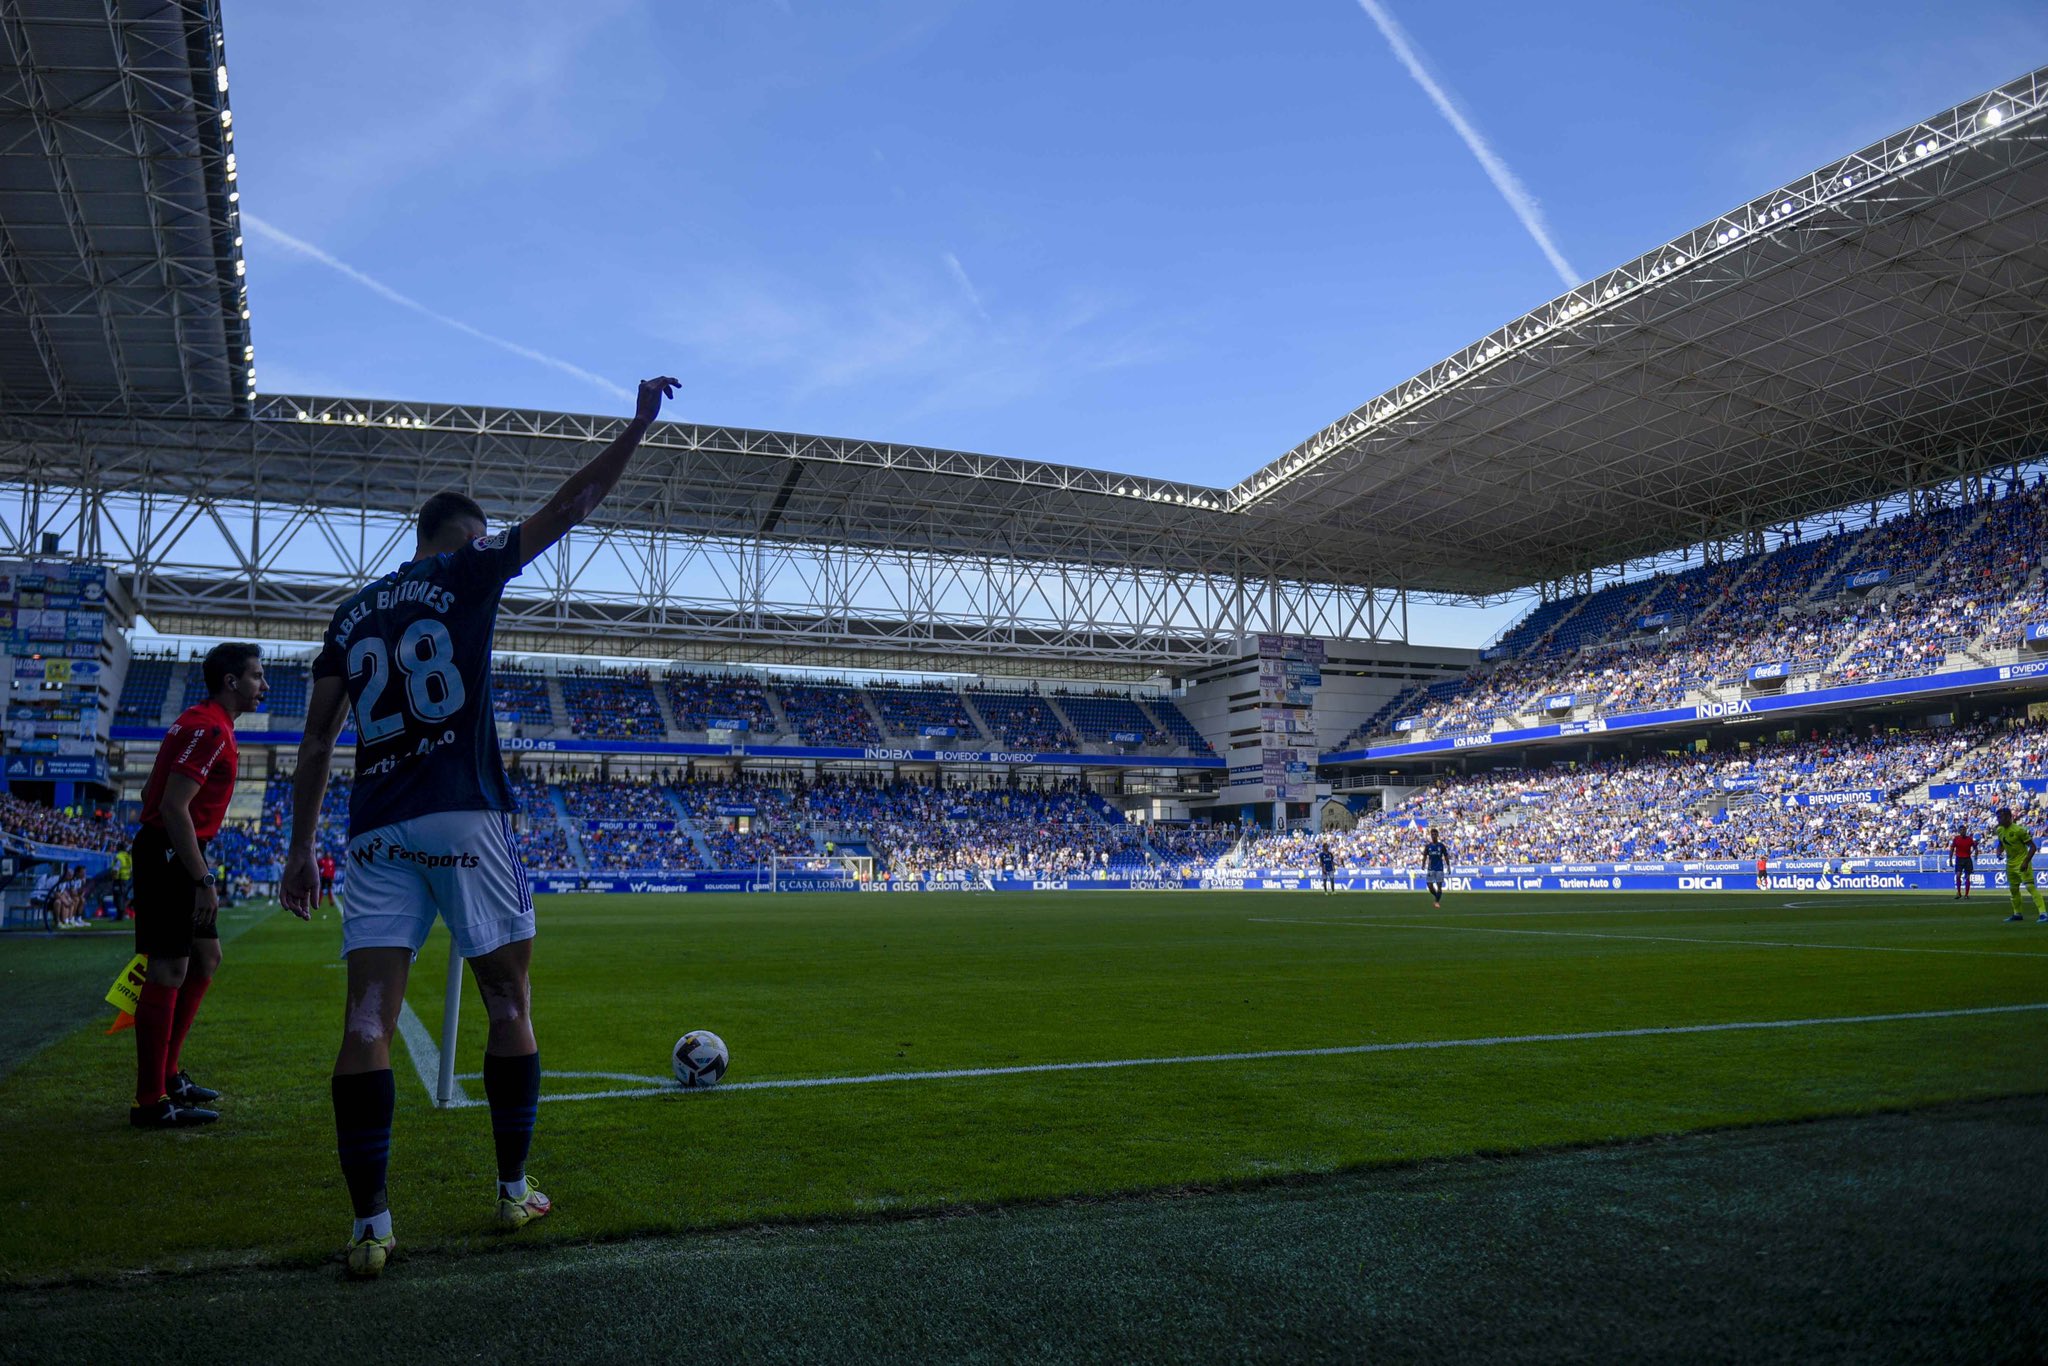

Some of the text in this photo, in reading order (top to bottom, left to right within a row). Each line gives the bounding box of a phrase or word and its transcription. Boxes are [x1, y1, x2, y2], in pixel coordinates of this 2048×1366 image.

[336, 602, 372, 650] ABEL
[2012, 663, 2046, 674] OVIEDO
[346, 618, 466, 748] 28
[1696, 700, 1752, 718] INDIBA
[1454, 734, 1492, 747] LOS PRADOS
[865, 749, 912, 759] INDIBA
[944, 752, 978, 761] OVIEDO
[1000, 753, 1032, 762] OVIEDO
[1958, 785, 1969, 795] AL
[1809, 791, 1871, 805] BIENVENIDOS
[389, 845, 479, 868] FanSports
[647, 884, 687, 892] FanSports
[789, 880, 854, 889] CASA LOBATO
[861, 880, 918, 892] alsa alsa
[1033, 881, 1068, 889] DIGI
[1559, 878, 1609, 888] Tartiere Auto
[1679, 877, 1722, 889] DIGI
[1773, 875, 1904, 890] LaLiga SmartBank
